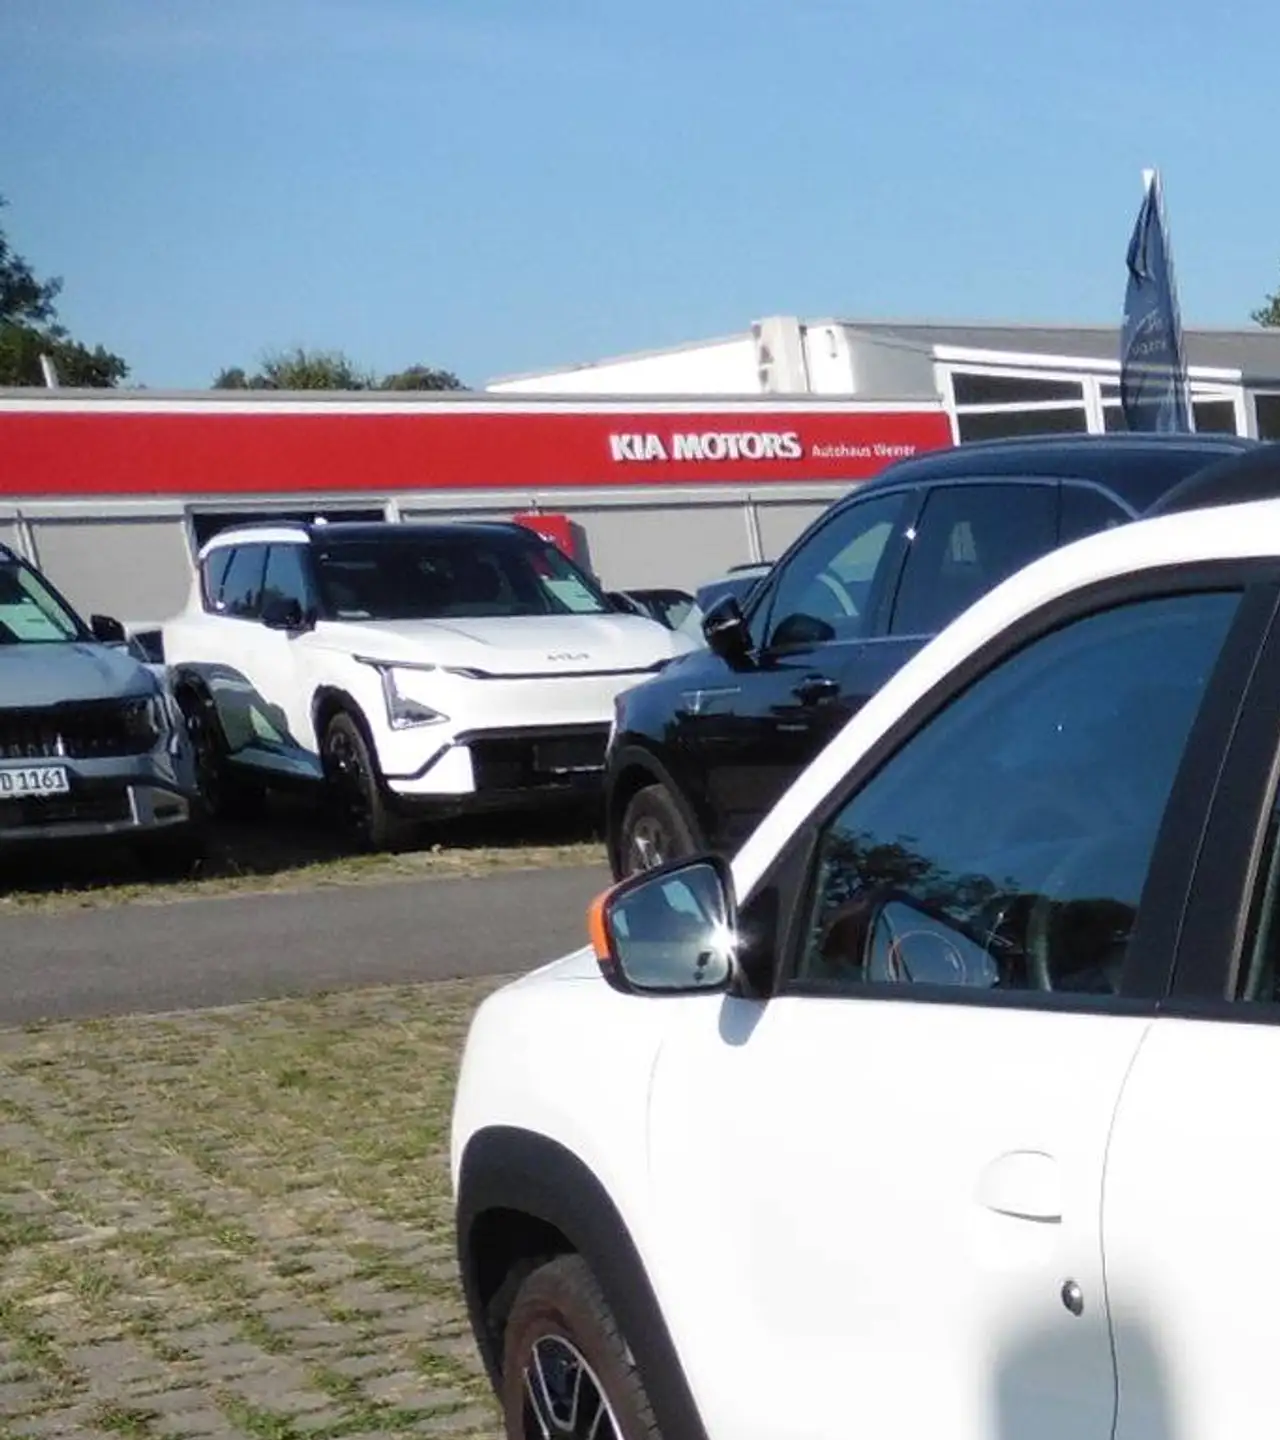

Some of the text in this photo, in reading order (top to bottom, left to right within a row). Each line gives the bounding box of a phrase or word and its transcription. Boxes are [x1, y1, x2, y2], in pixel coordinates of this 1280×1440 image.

[609, 432, 802, 461] KIA MOTORS
[811, 444, 871, 458] Autohaus
[19, 770, 65, 790] 1161
